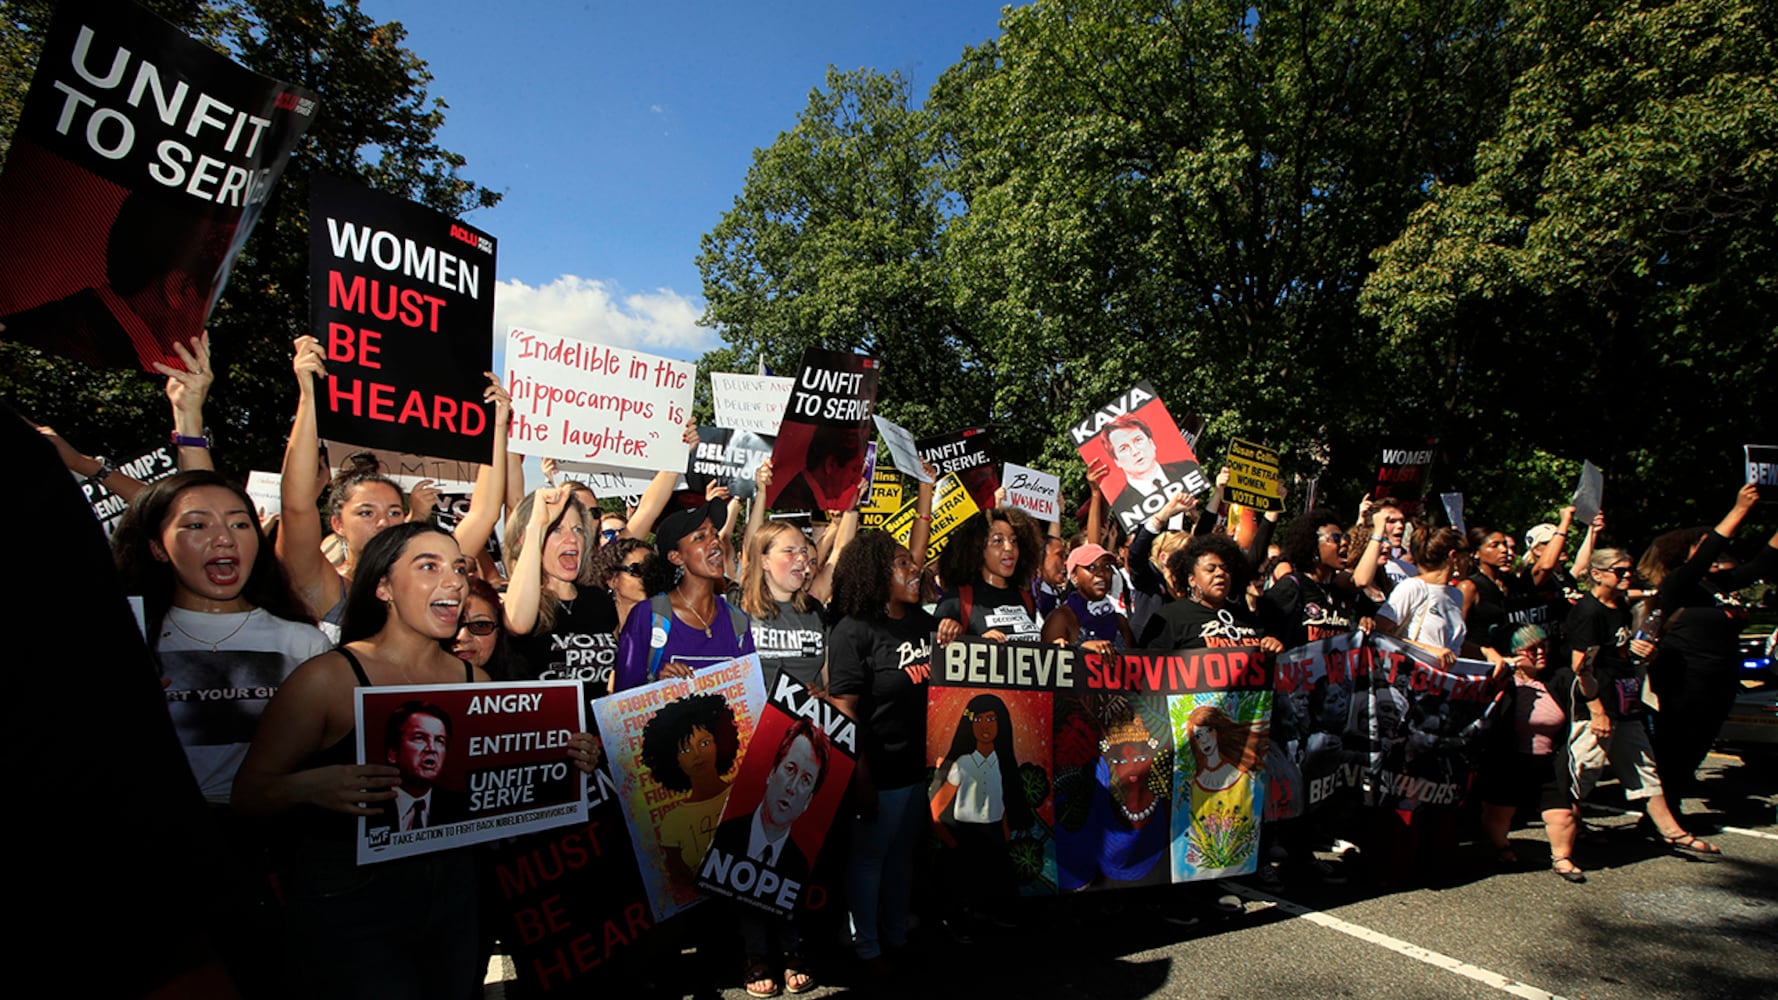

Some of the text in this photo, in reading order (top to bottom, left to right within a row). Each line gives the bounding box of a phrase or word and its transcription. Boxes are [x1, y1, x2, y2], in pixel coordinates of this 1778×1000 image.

[72, 25, 270, 158] UNFIT
[54, 80, 135, 159] TO
[449, 224, 478, 247] ACLU
[327, 218, 480, 299] WOMEN
[328, 270, 446, 332] MUST
[328, 322, 382, 370] BE
[629, 356, 648, 381] in
[654, 360, 688, 390] the
[723, 379, 765, 391] BELIEVE
[802, 366, 863, 395] UNFIT
[328, 374, 487, 437] HEARD
[509, 370, 684, 425] hippocampus is
[724, 399, 762, 412] BELIEVE
[795, 392, 822, 417] TO
[508, 411, 549, 442] the
[1071, 387, 1153, 444] KAVA
[943, 450, 990, 473] SERVE.
[1228, 459, 1250, 475] DON'T
[1382, 449, 1433, 465] WOMEN
[1007, 474, 1055, 496] Believe
[1377, 466, 1418, 484] MUST
[931, 490, 967, 521] ETRAY
[1010, 491, 1053, 515] WOMEN
[1231, 489, 1270, 509] VOTE NO
[863, 514, 884, 525] NO
[885, 507, 917, 533] Susan
[1508, 604, 1549, 625] UNFIT
[551, 632, 617, 650] VOTE
[566, 649, 616, 667] PRO
[944, 641, 1075, 689] BELIEVE
[1084, 652, 1265, 692] SURVIVORS
[617, 663, 742, 715] FIGHT FOR JUSTICE
[1274, 659, 1316, 694] WE
[197, 689, 250, 701] YOUR
[467, 693, 543, 715] ANGRY
[774, 673, 856, 754] KAVA
[468, 729, 572, 756] ENTITLED
[469, 762, 568, 792] UNFIT TO
[468, 784, 535, 812] SERVE
[369, 832, 390, 847] WF
[392, 833, 413, 846] TAKE
[415, 830, 444, 844] ACTION
[445, 827, 455, 838] TO
[455, 823, 475, 835] FIGHT
[476, 820, 495, 832] BACK
[494, 820, 605, 902] MUST
[700, 847, 802, 911] NOPE
[511, 892, 573, 946] BE
